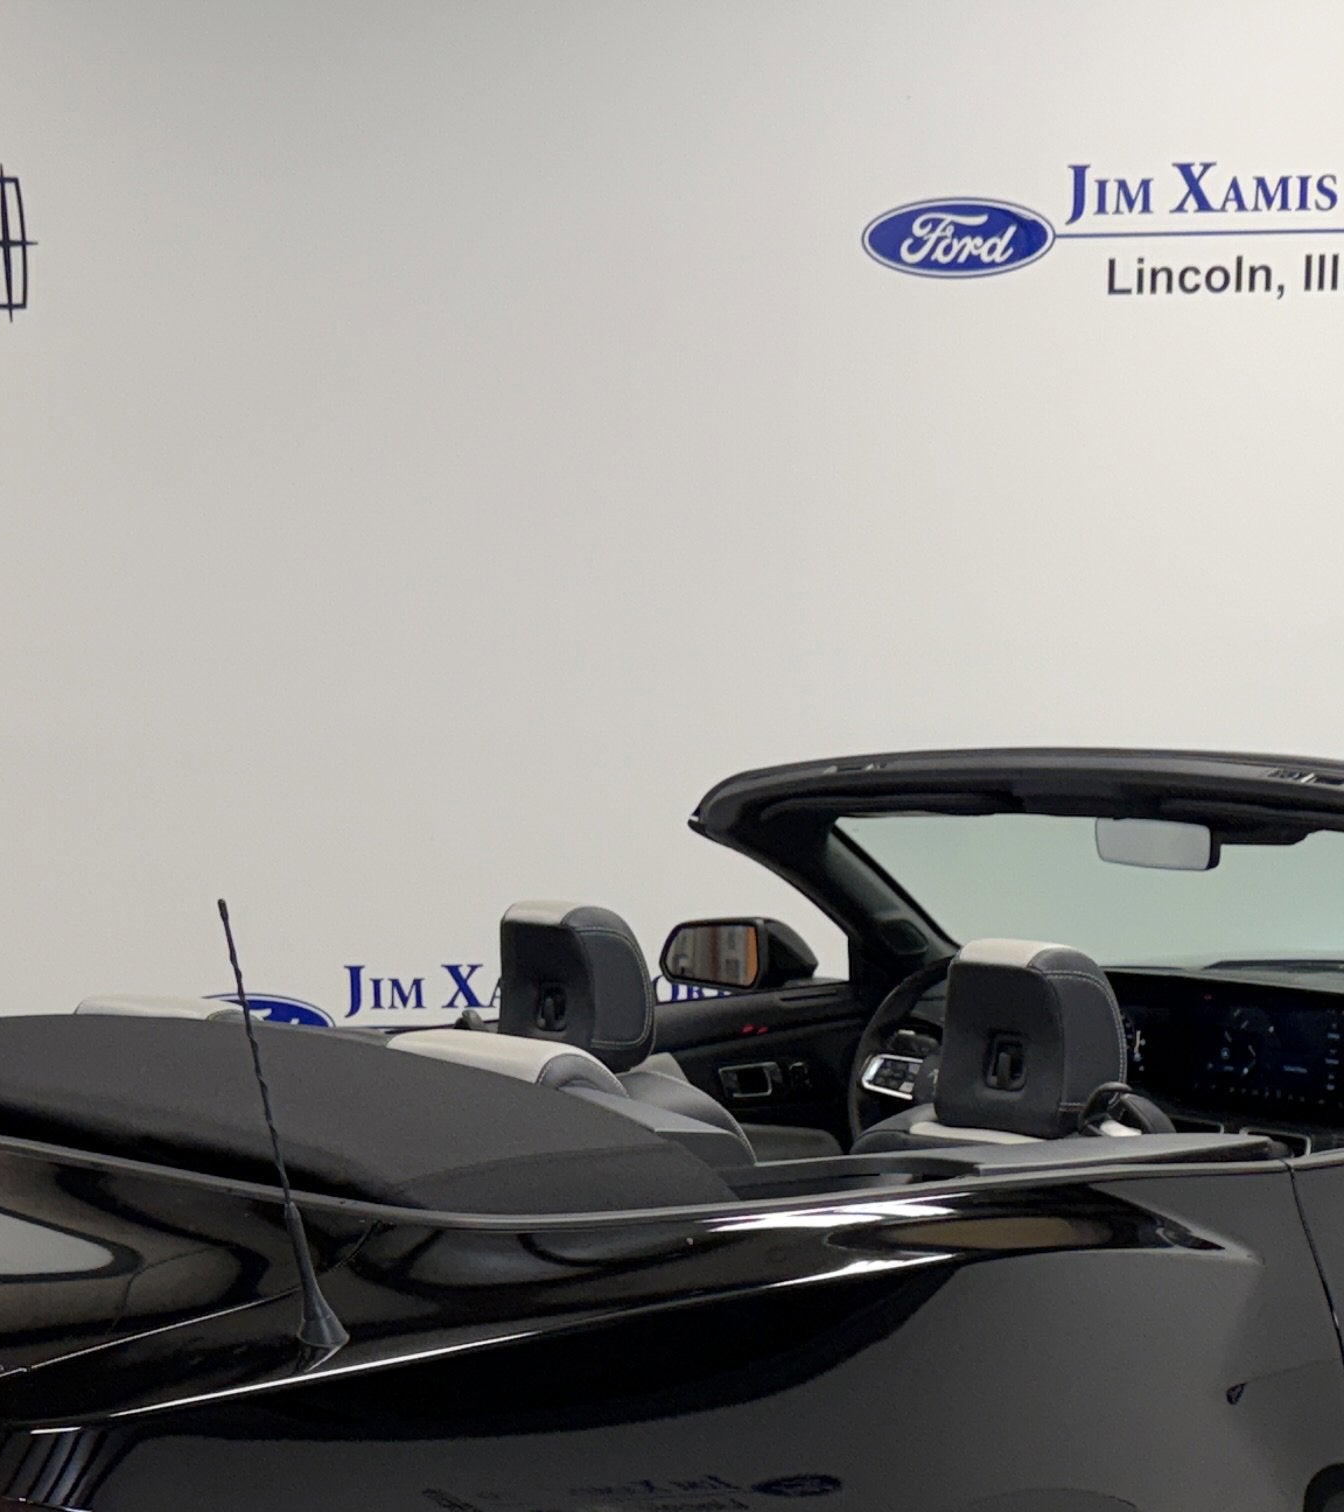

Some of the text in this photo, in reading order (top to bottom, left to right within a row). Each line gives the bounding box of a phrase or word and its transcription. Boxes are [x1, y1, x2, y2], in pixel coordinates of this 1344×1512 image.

[1066, 165, 1152, 225] JIM
[1172, 163, 1338, 213] XAMIS
[900, 212, 1017, 264] Ford
[1108, 256, 1285, 299] Lincoln,
[343, 965, 426, 1018] JIM
